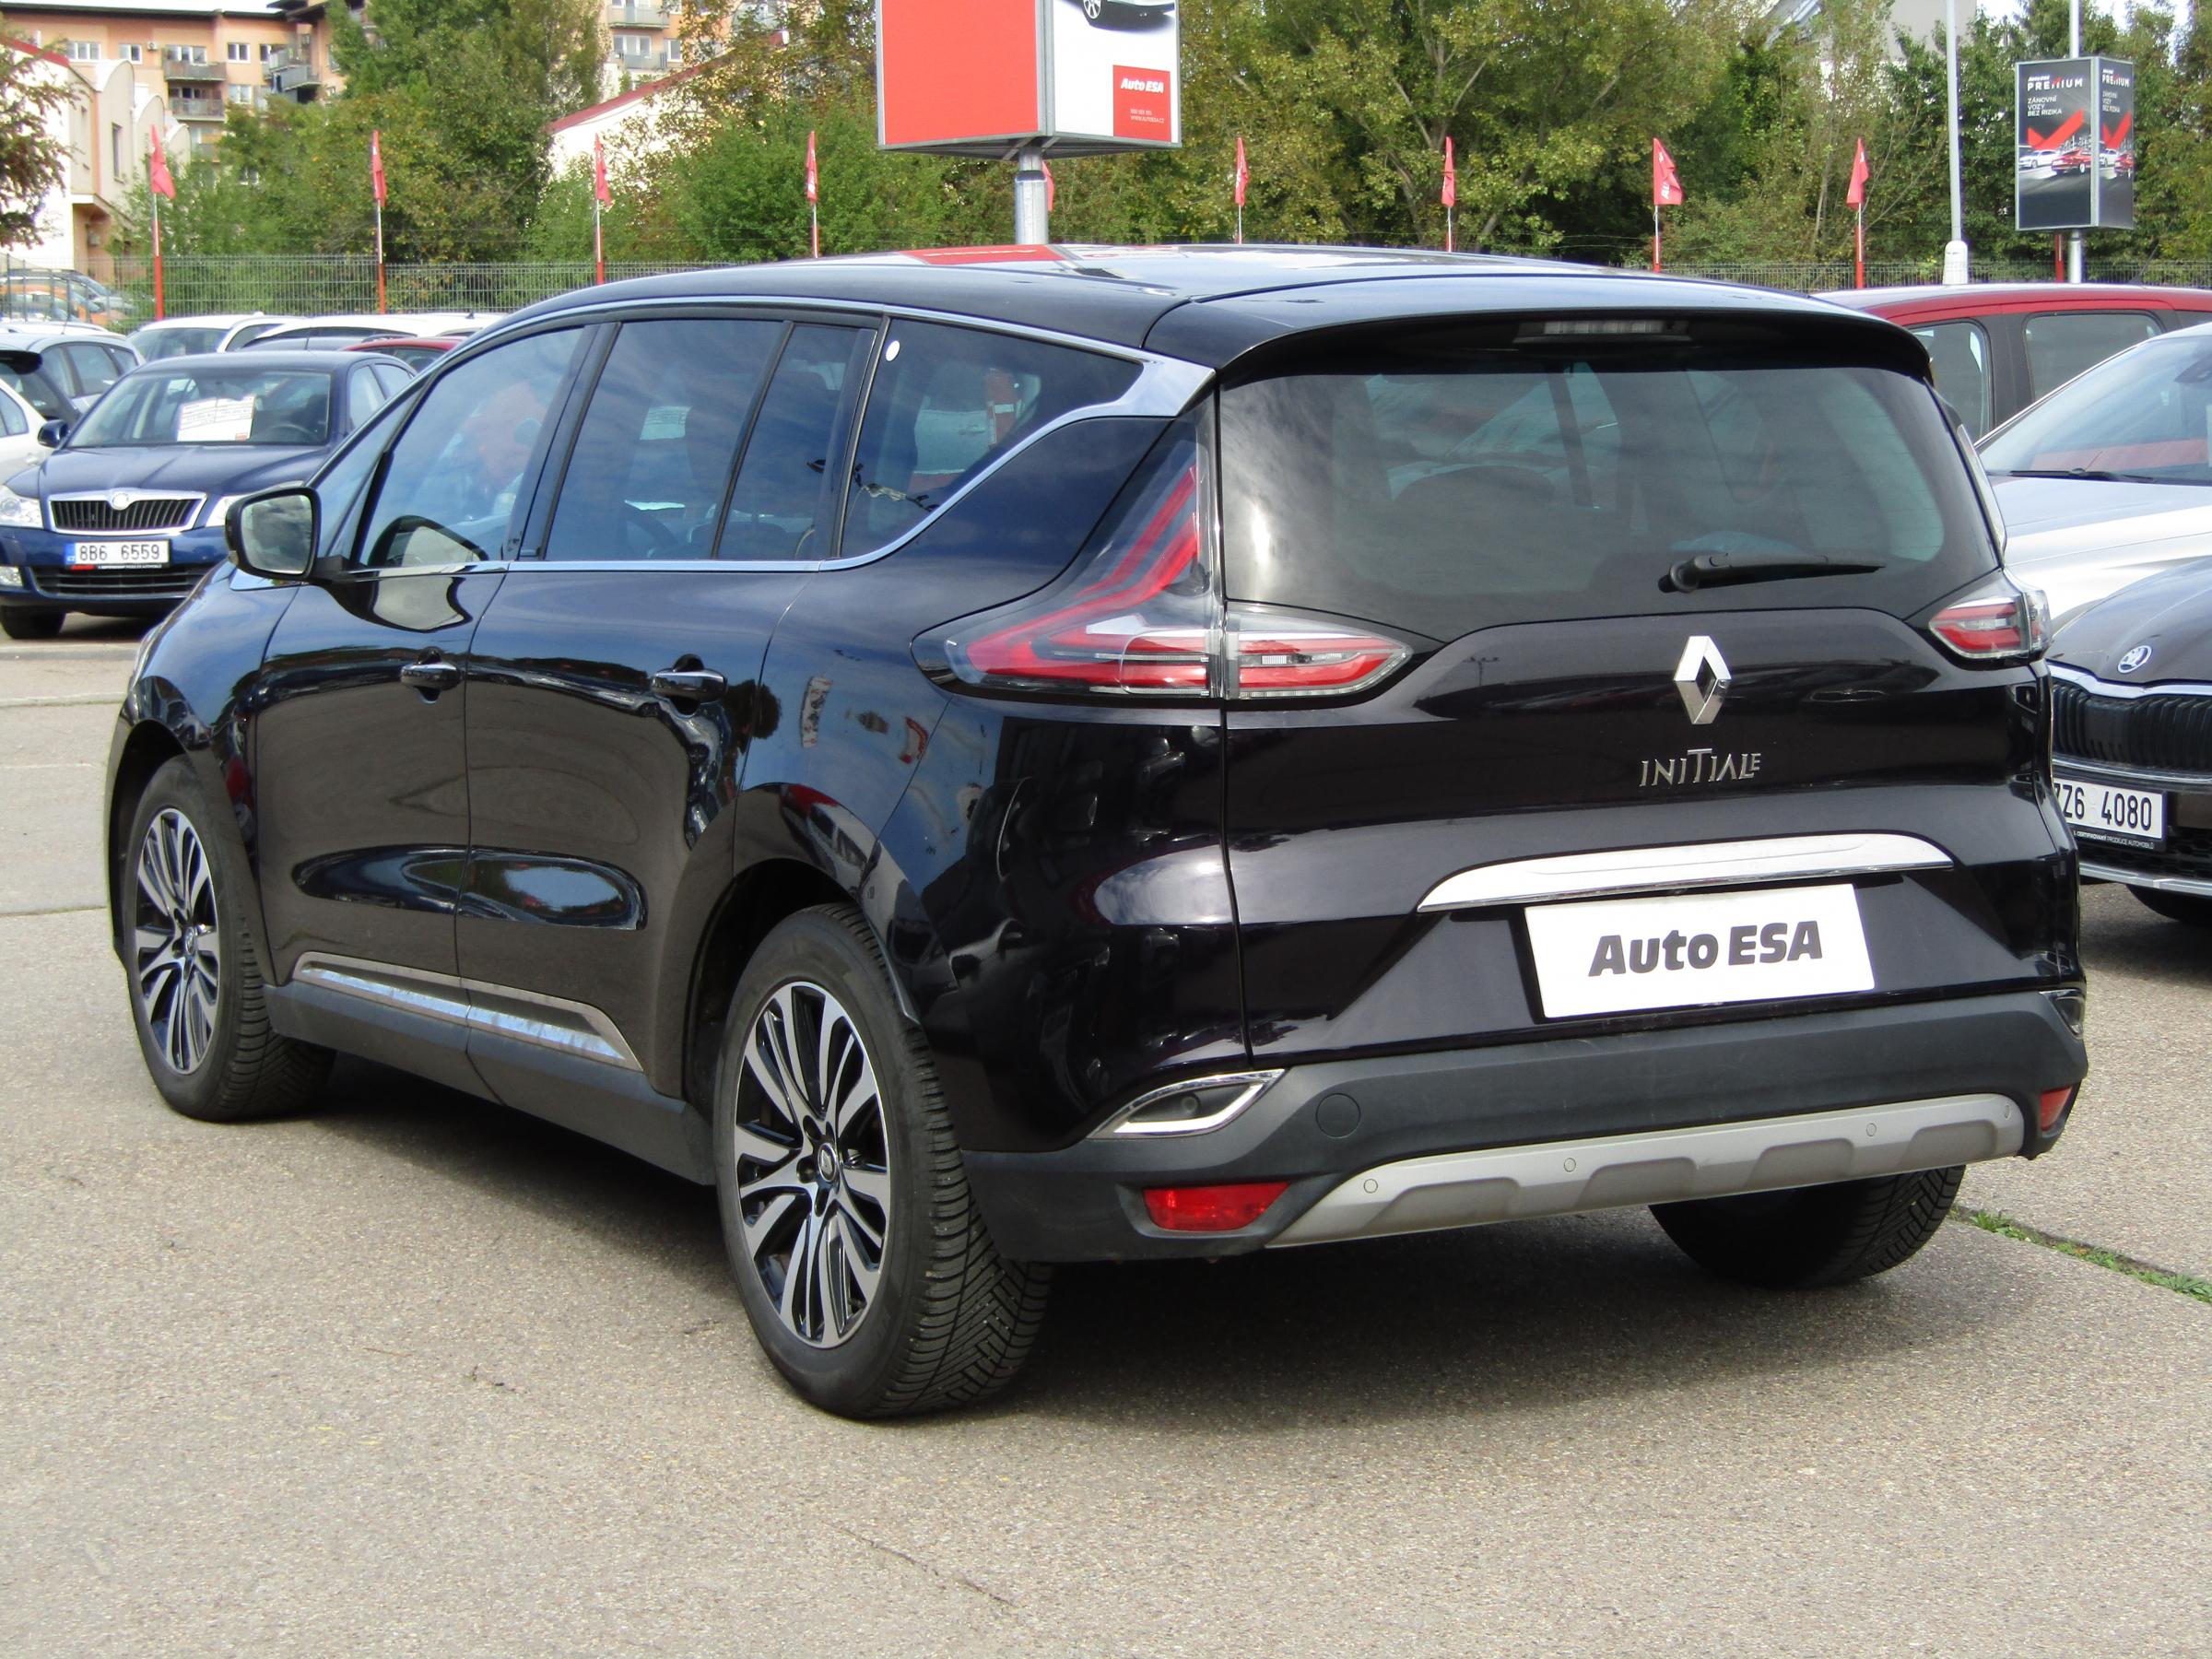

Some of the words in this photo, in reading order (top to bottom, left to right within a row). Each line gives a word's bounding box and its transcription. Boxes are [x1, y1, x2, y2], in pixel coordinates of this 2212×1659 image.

[1121, 78, 1145, 91] Auto
[1146, 81, 1164, 94] ESA
[2028, 76, 2083, 91] PREMIUM
[79, 545, 108, 561] 8B6
[121, 544, 159, 560] 6559
[1639, 747, 1761, 787] INITIALE
[2101, 791, 2152, 831] 4080
[1588, 929, 1719, 977] Auto
[1728, 920, 1823, 966] ESA
